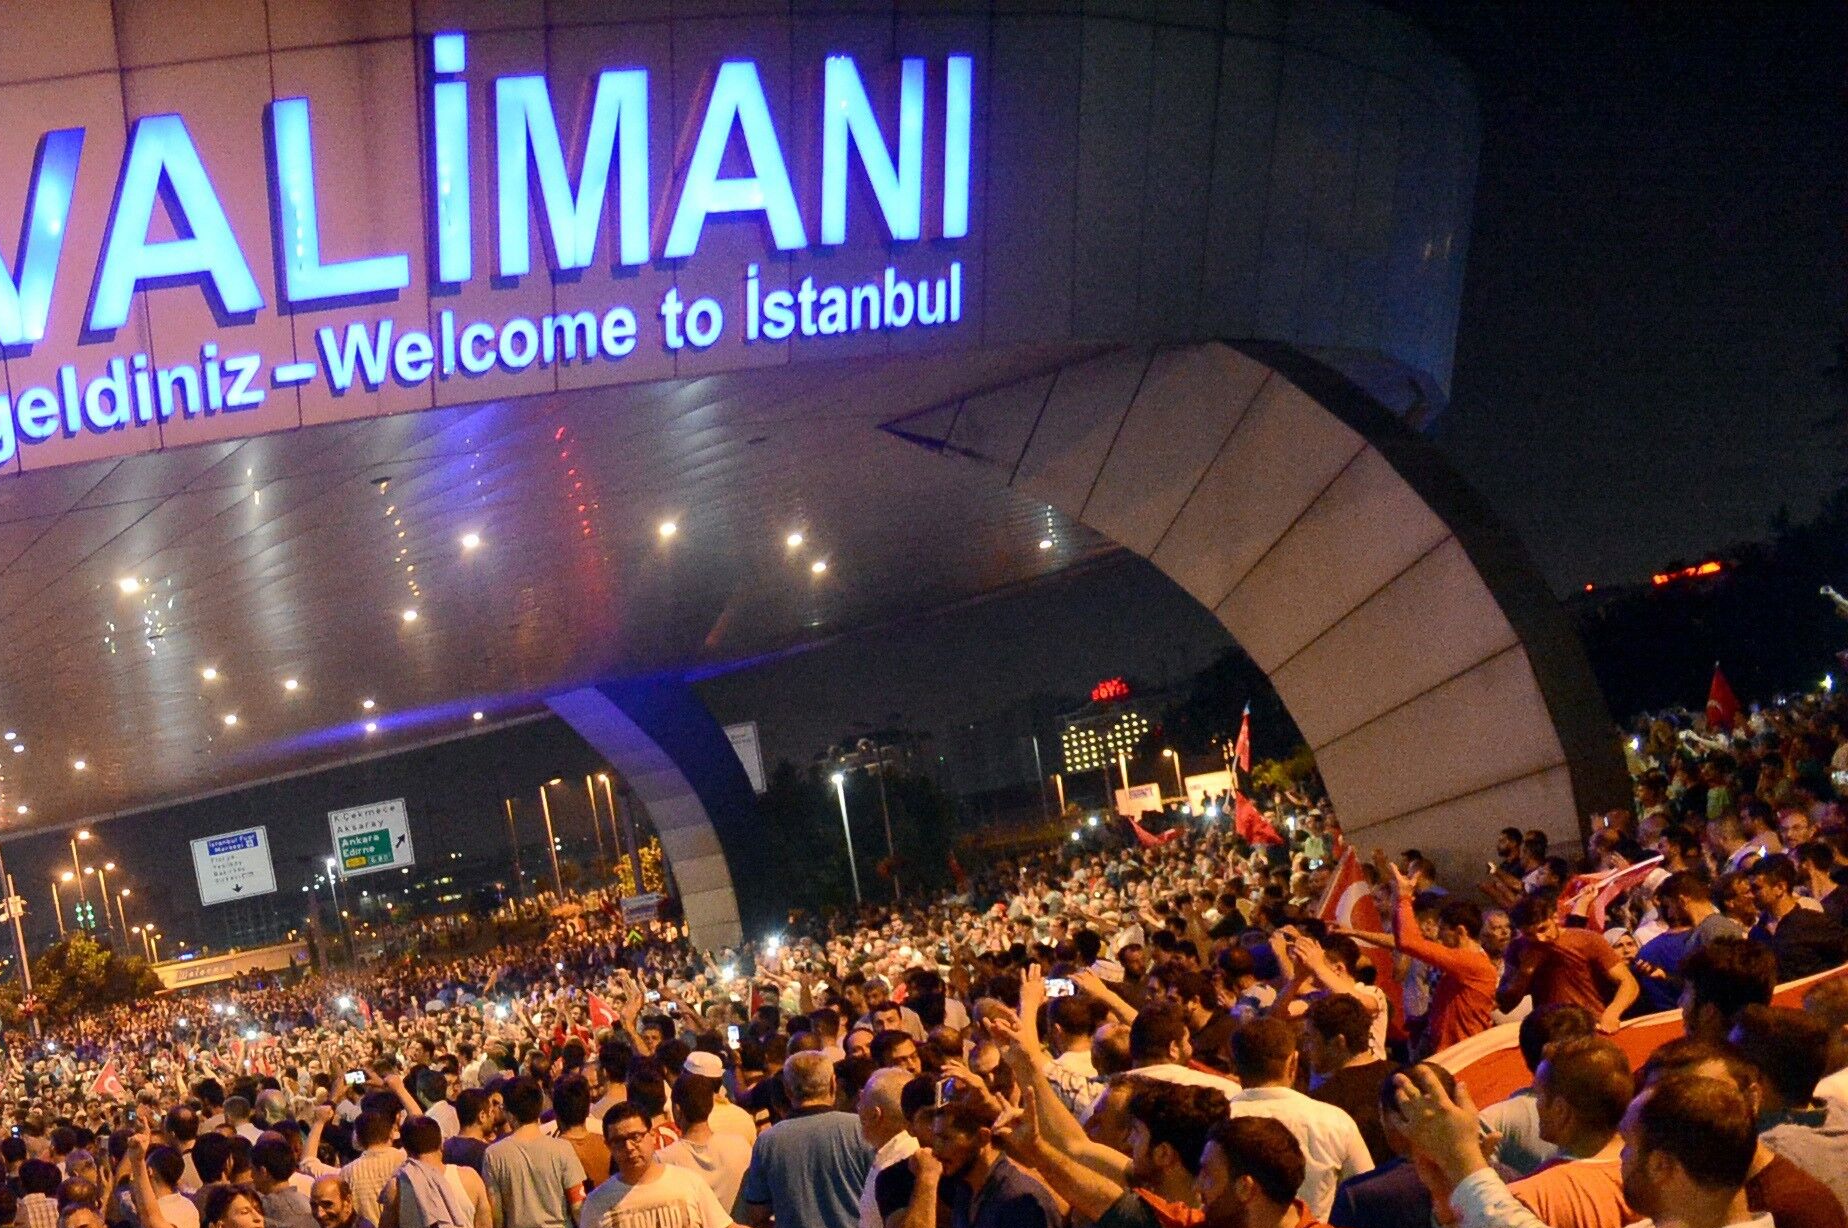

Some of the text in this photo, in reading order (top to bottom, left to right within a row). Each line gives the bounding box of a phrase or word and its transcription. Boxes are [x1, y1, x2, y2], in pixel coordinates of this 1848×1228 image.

[660, 287, 724, 350] to
[746, 262, 963, 342] İstanbul
[341, 834, 380, 848] Ankara
[342, 845, 376, 858] Edirne
